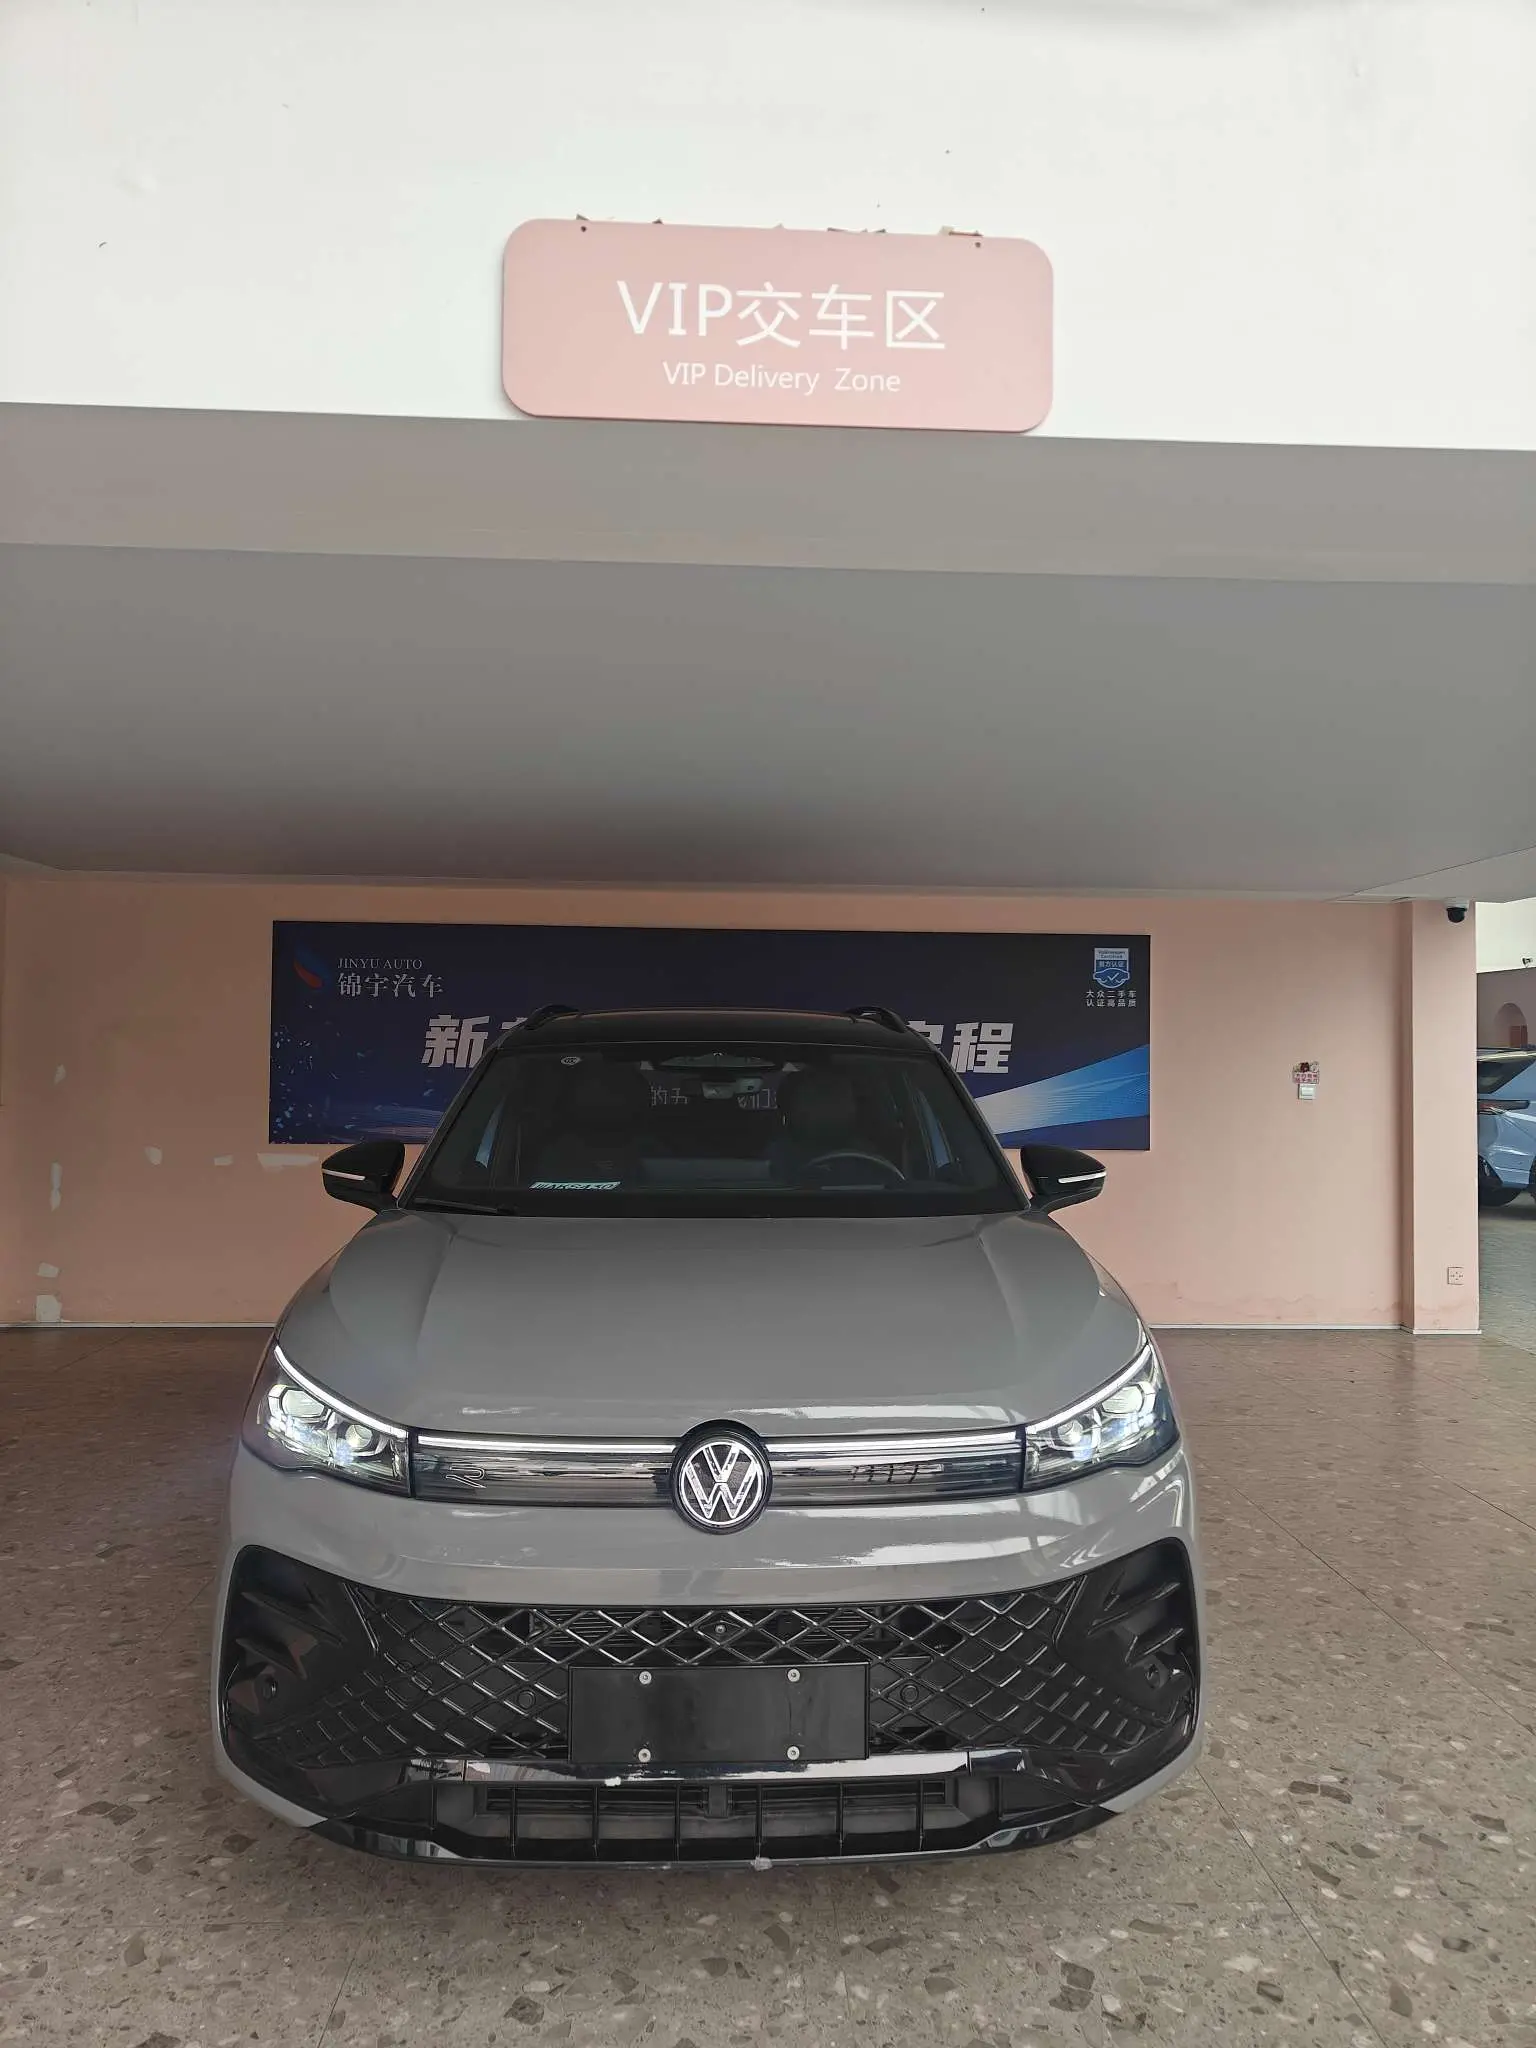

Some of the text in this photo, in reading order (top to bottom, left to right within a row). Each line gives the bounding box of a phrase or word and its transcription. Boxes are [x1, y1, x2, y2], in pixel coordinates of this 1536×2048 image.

[616, 281, 946, 351] VIP交车区
[662, 361, 901, 395] VIP Delivery Zone
[337, 957, 423, 970] JINYU AUTO
[337, 972, 444, 998] 锦宇汽车
[1086, 989, 1137, 999] 大众二手车
[1086, 999, 1137, 1008] 认证高品质
